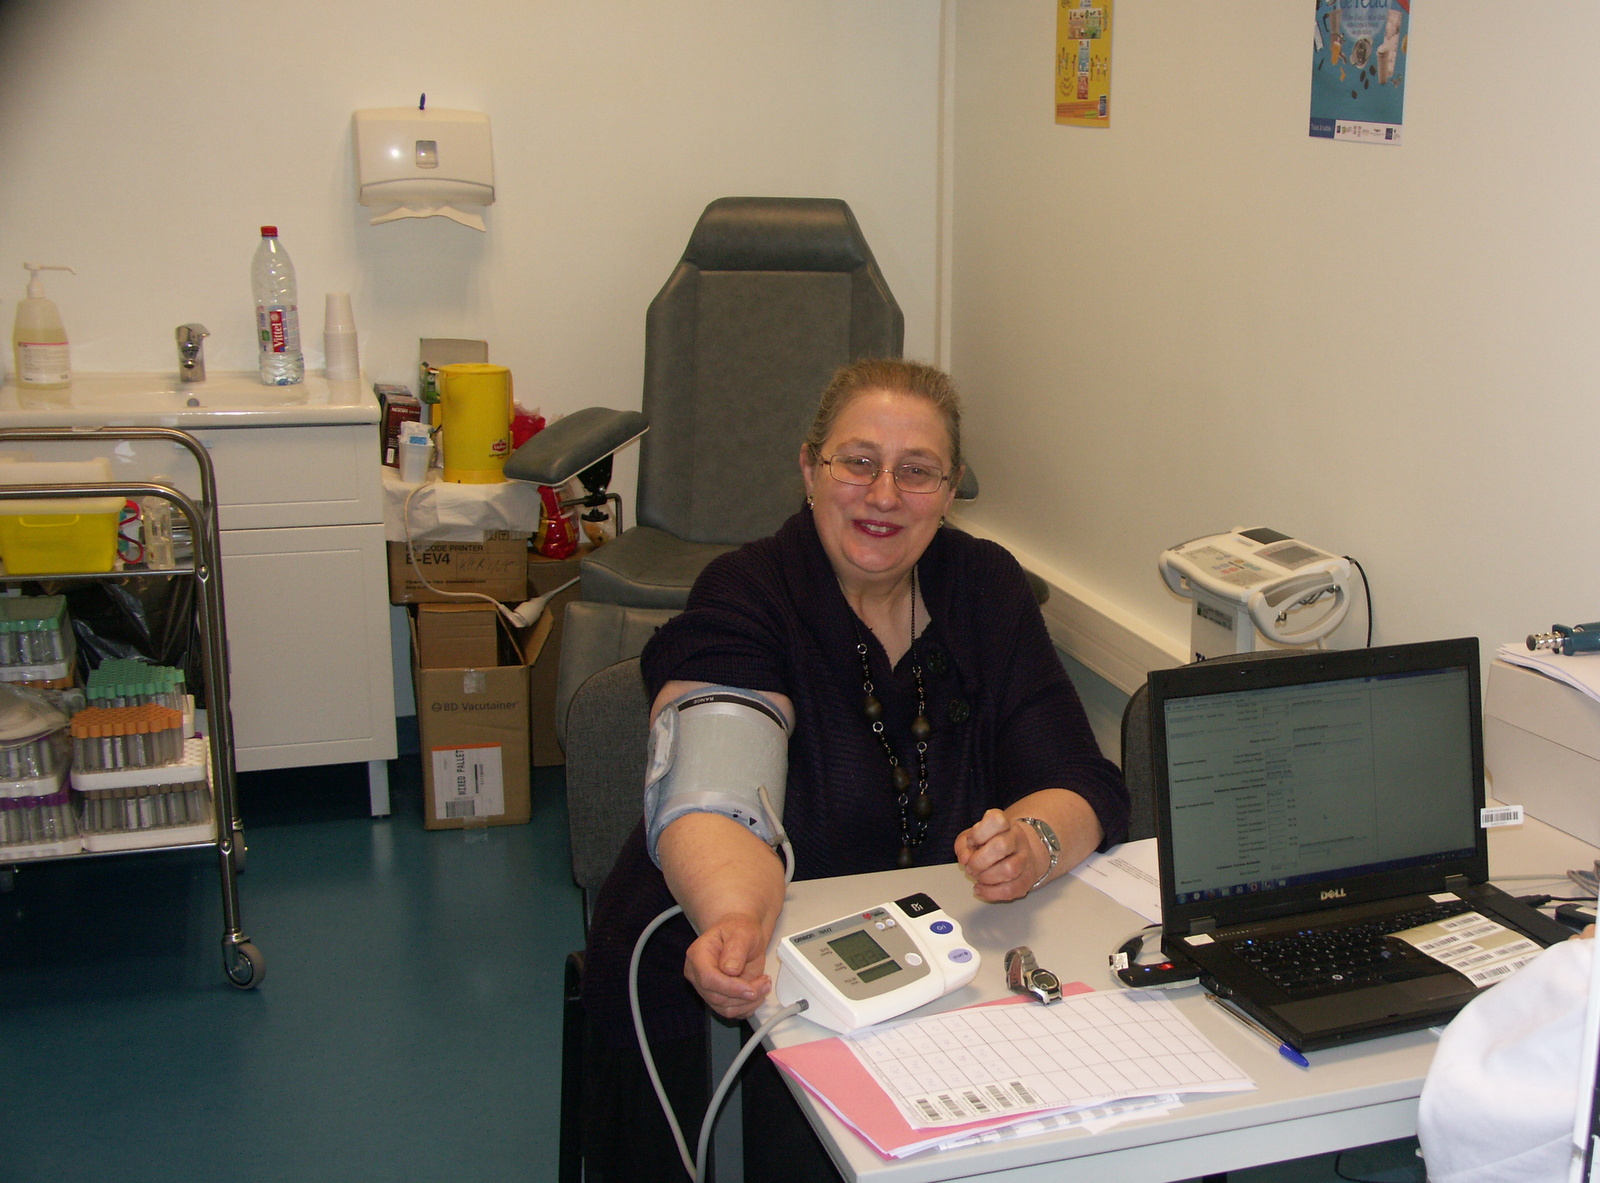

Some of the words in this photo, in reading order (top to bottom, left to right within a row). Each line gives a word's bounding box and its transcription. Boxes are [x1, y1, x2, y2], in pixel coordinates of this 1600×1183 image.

[271, 322, 284, 347] Vittel
[449, 544, 484, 552] PRINTER
[405, 553, 450, 565] E-EV4
[443, 702, 458, 712] BD
[462, 701, 517, 711] Vacutainer
[455, 749, 465, 773] PALLET
[457, 775, 466, 796] MIXED
[1320, 888, 1347, 900] DELL
